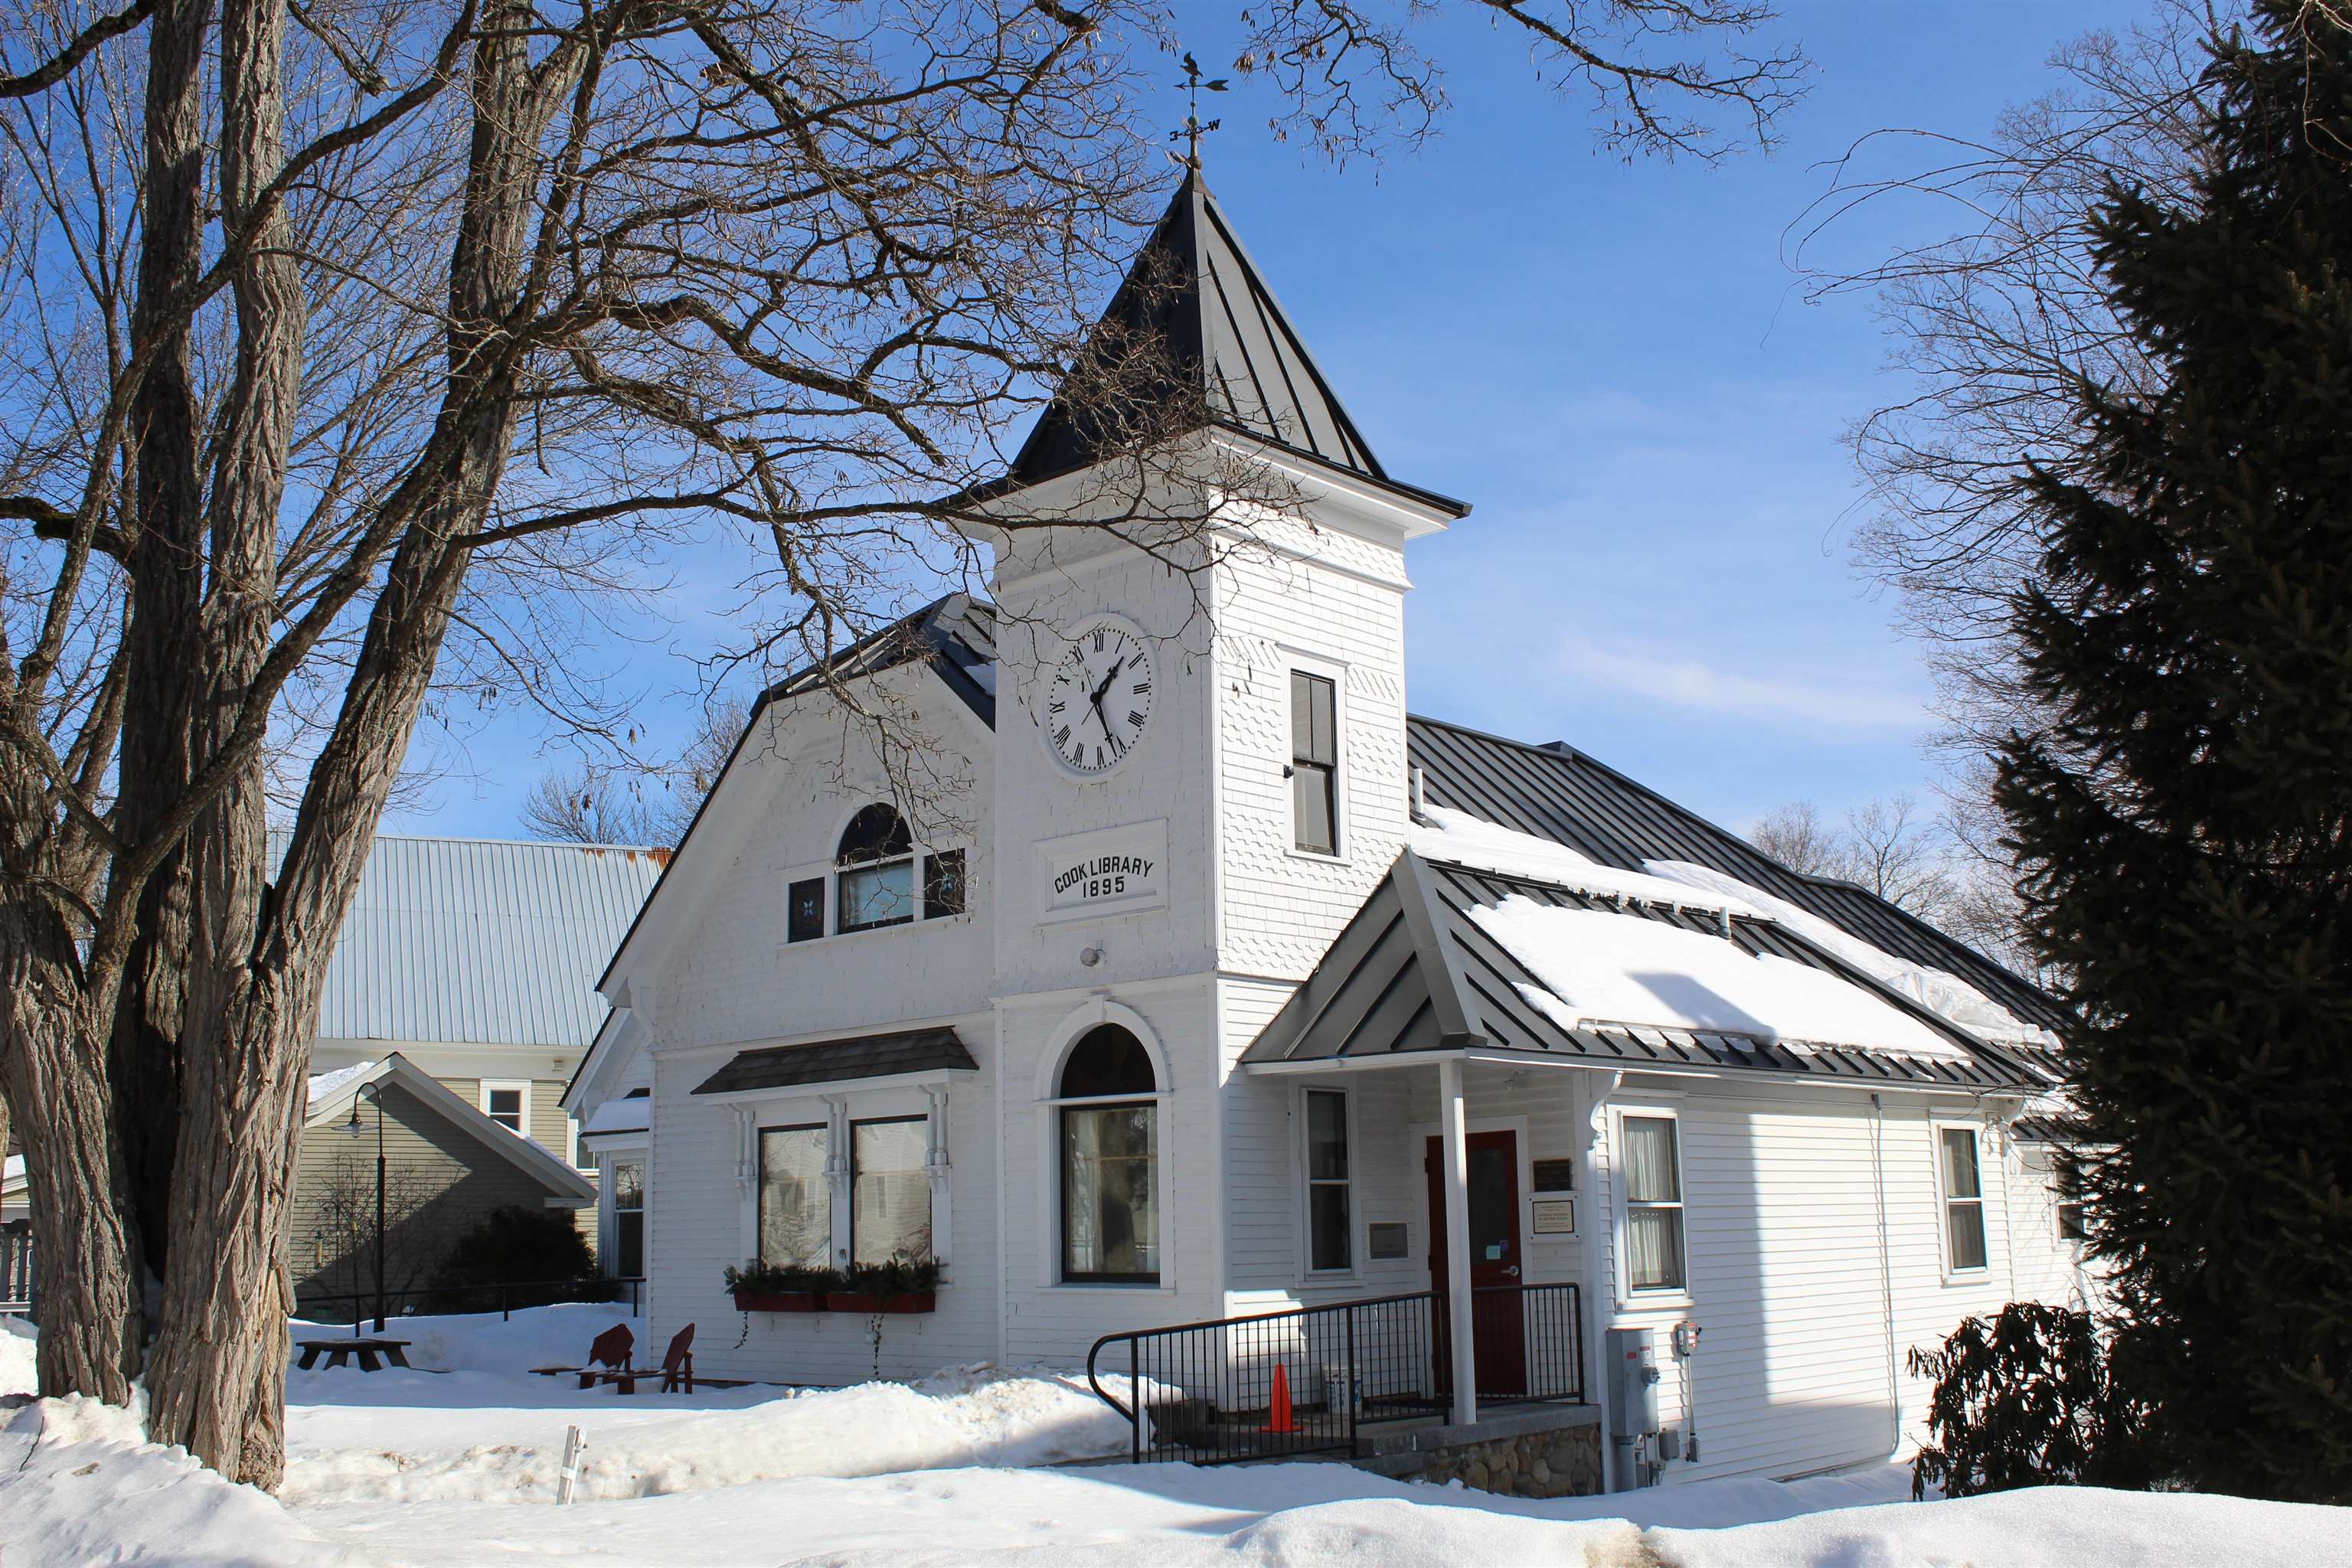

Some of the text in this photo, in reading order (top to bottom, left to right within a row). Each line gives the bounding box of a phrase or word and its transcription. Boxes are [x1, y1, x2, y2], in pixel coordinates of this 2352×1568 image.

[1208, 119, 1220, 131] W
[1093, 632, 1104, 654] XII
[1115, 635, 1124, 654] I
[1072, 646, 1084, 666] XI
[1128, 654, 1142, 670] II
[1057, 675, 1070, 685] X
[1133, 683, 1148, 694] III
[1052, 701, 1065, 714] IX
[1056, 724, 1072, 750] VIII
[1116, 736, 1126, 753] V
[1073, 742, 1084, 764] VII
[1097, 746, 1105, 766] VI
[1054, 856, 1155, 894] COOK LIBRARY
[1083, 876, 1125, 899] 1895
